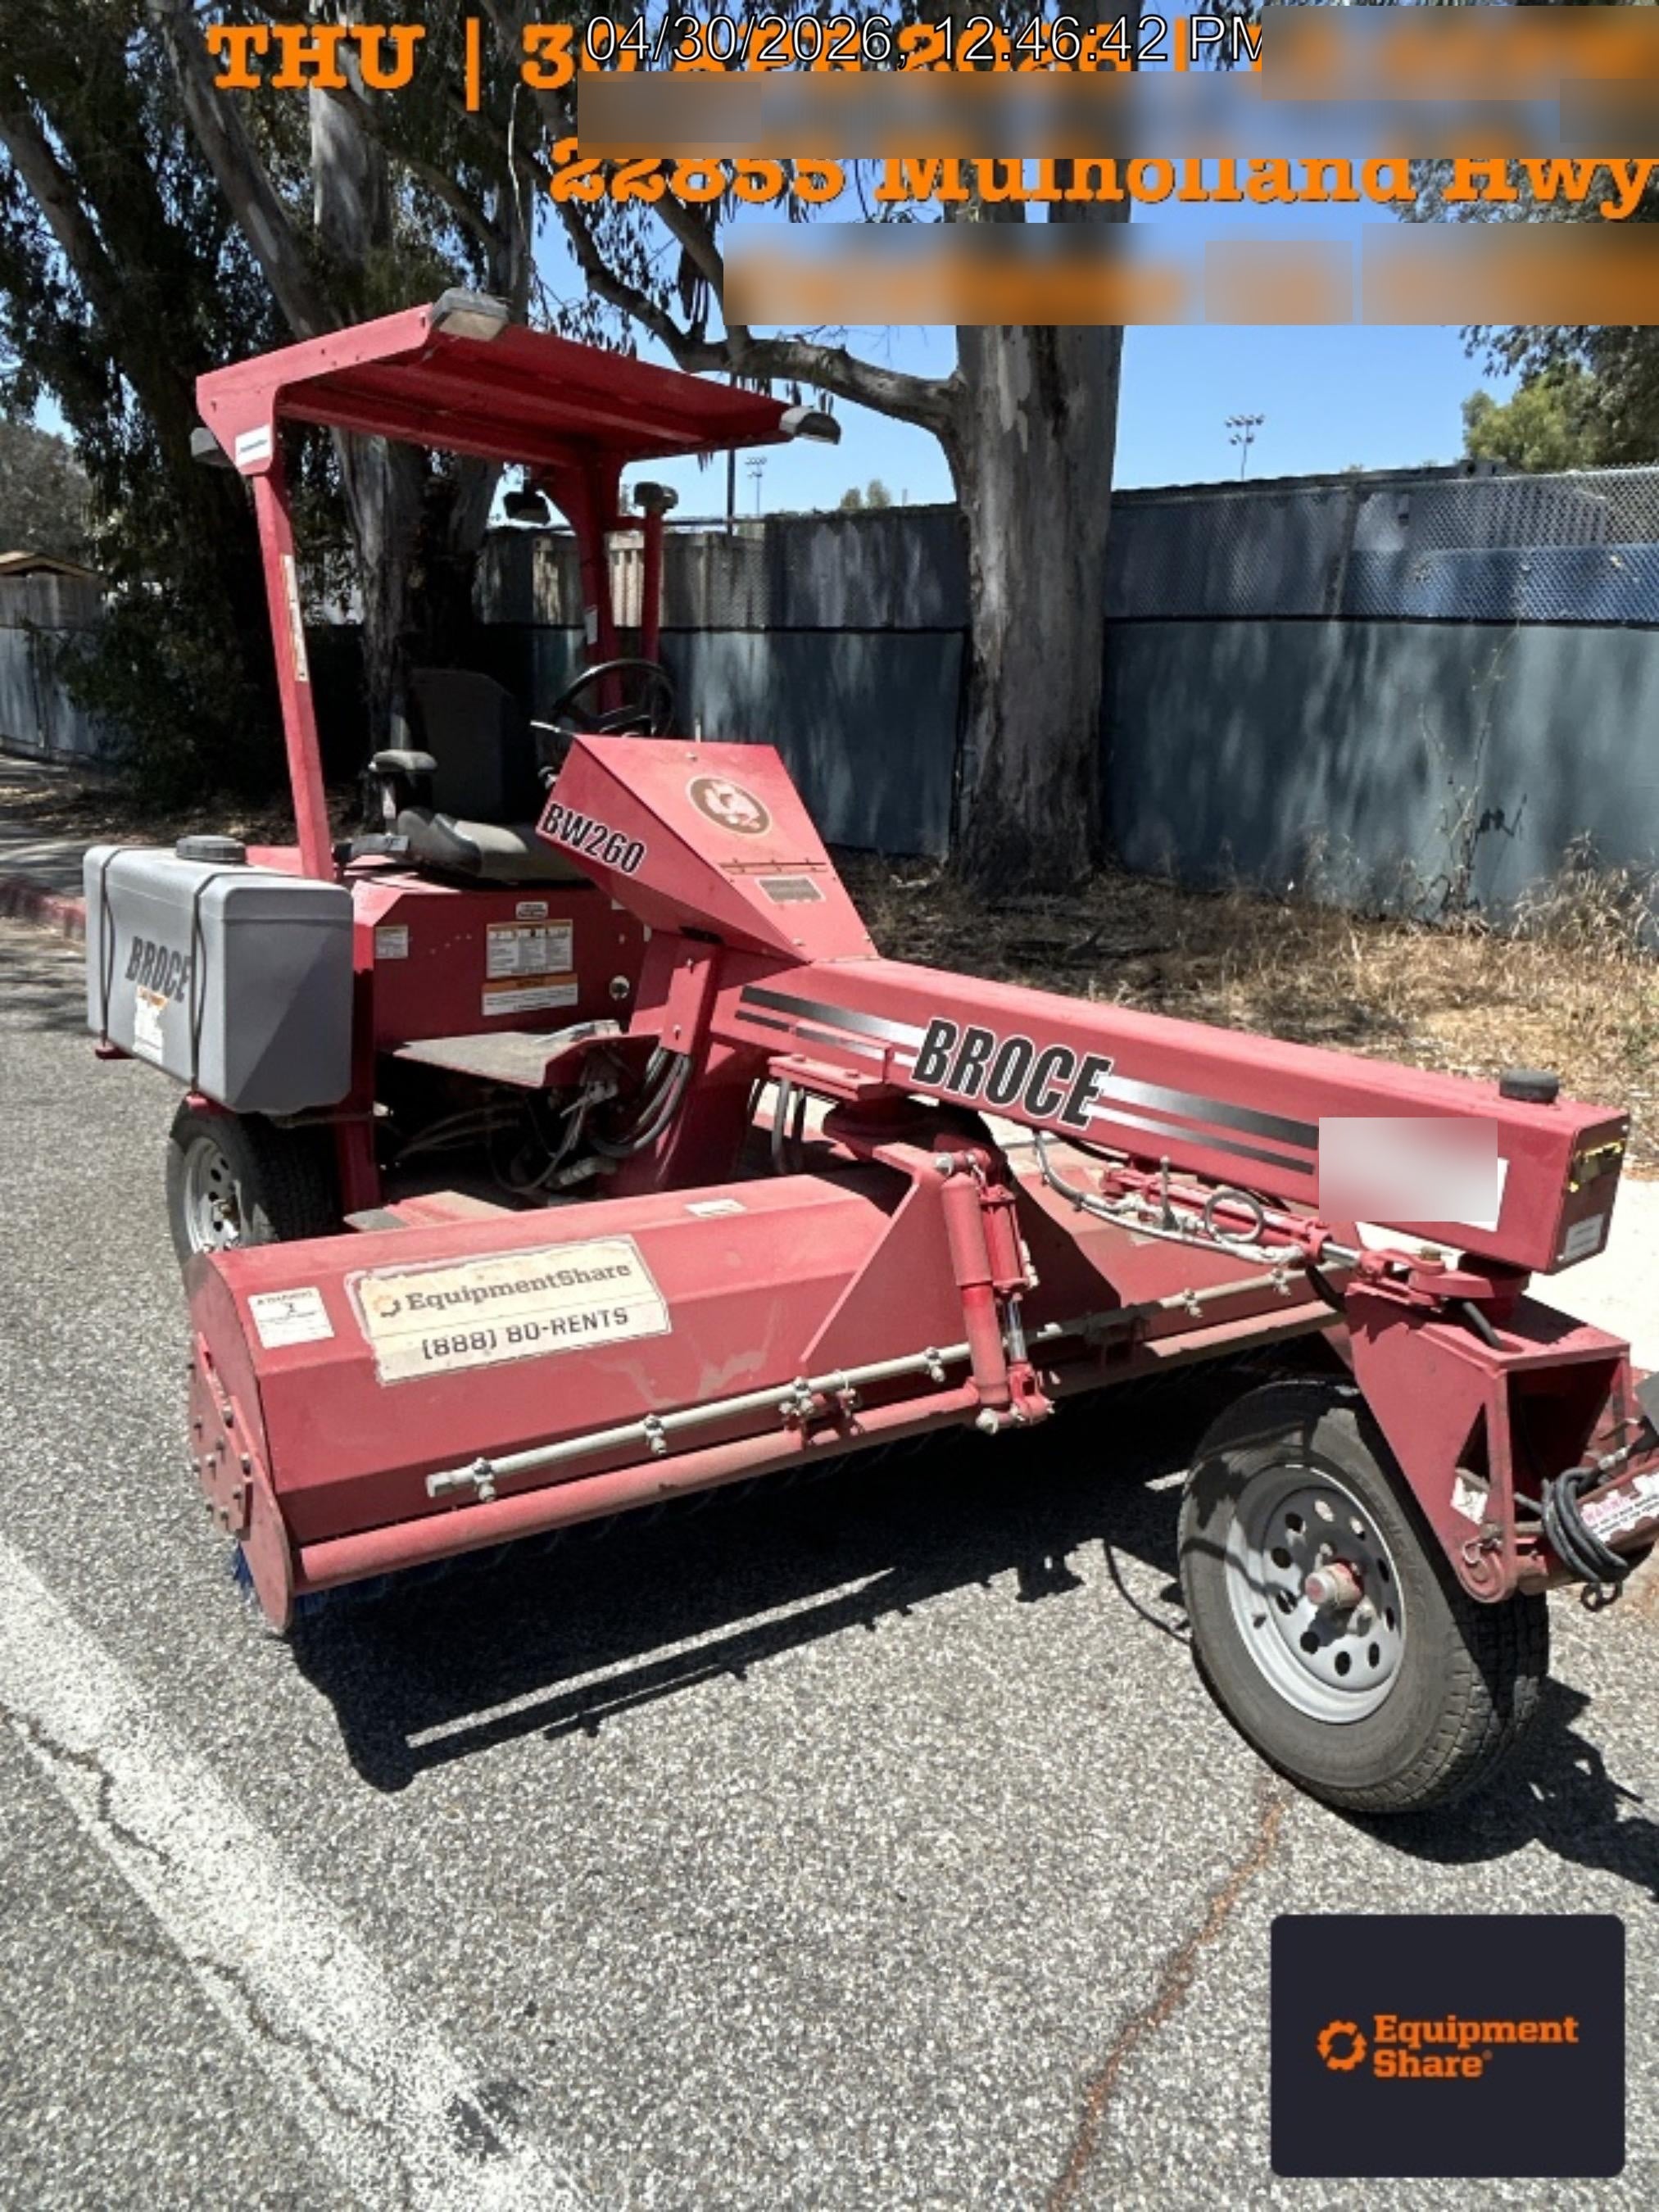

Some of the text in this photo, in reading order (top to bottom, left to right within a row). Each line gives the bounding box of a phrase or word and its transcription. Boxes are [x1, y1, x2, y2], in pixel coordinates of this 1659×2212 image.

[540, 802, 646, 873] BW260
[911, 1018, 1113, 1129] BROCE
[406, 1264, 632, 1311] EquipmentShare
[421, 1329, 497, 1360] (888)
